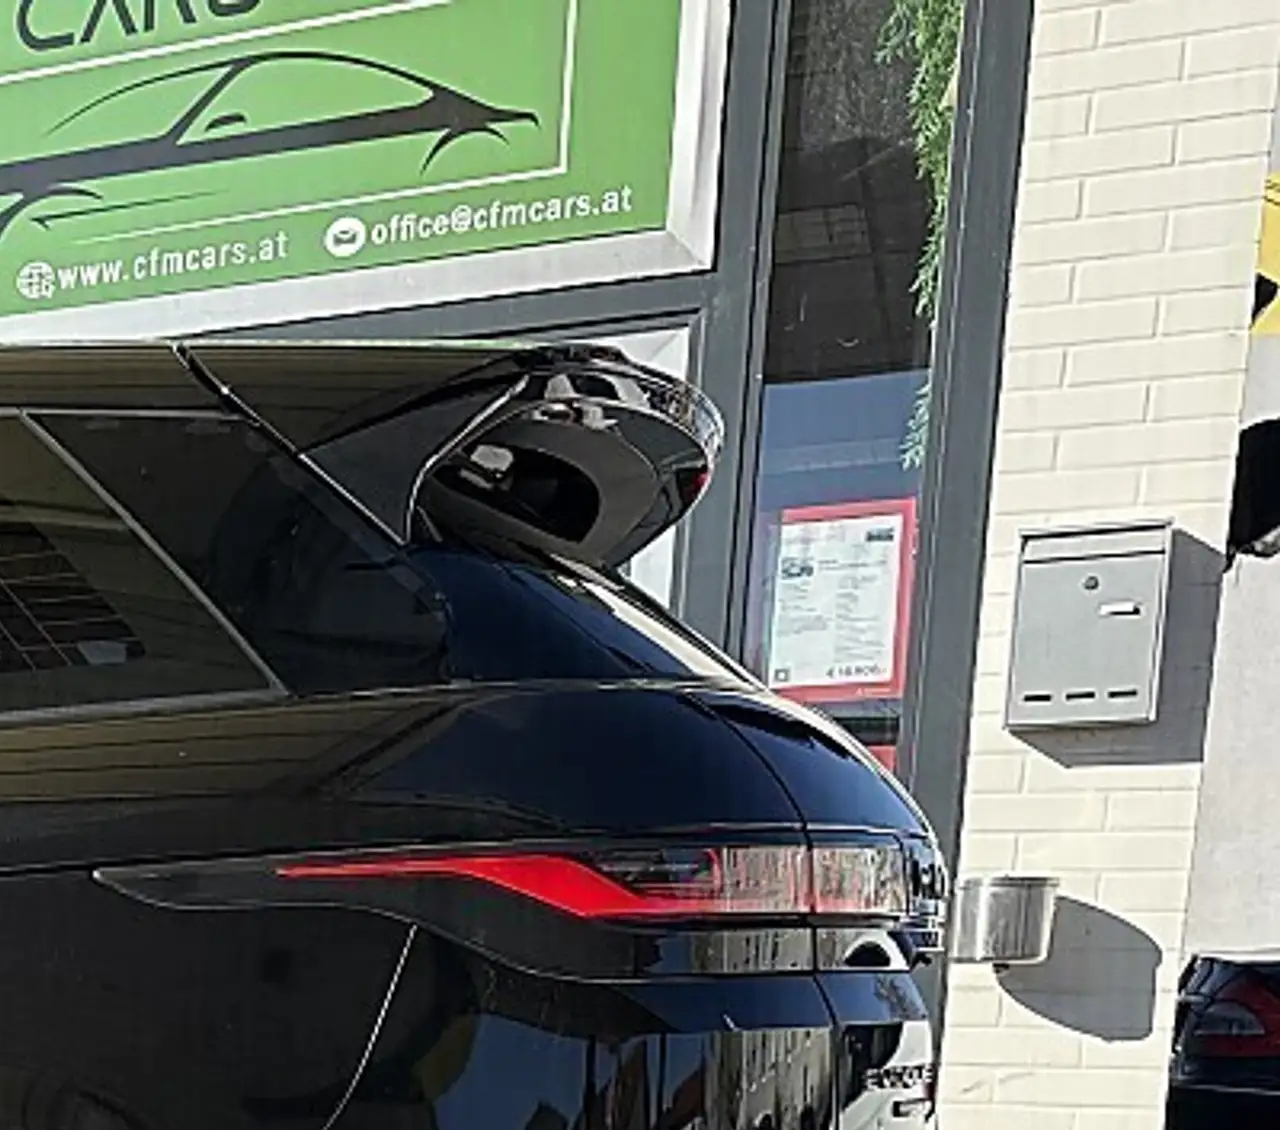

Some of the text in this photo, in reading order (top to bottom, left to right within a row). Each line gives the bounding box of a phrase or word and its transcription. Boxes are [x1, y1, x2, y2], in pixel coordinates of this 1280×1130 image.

[17, 0, 261, 51] CA
[371, 184, 633, 245] office@cfmcars.at
[57, 231, 288, 290] www.cfmcars.at
